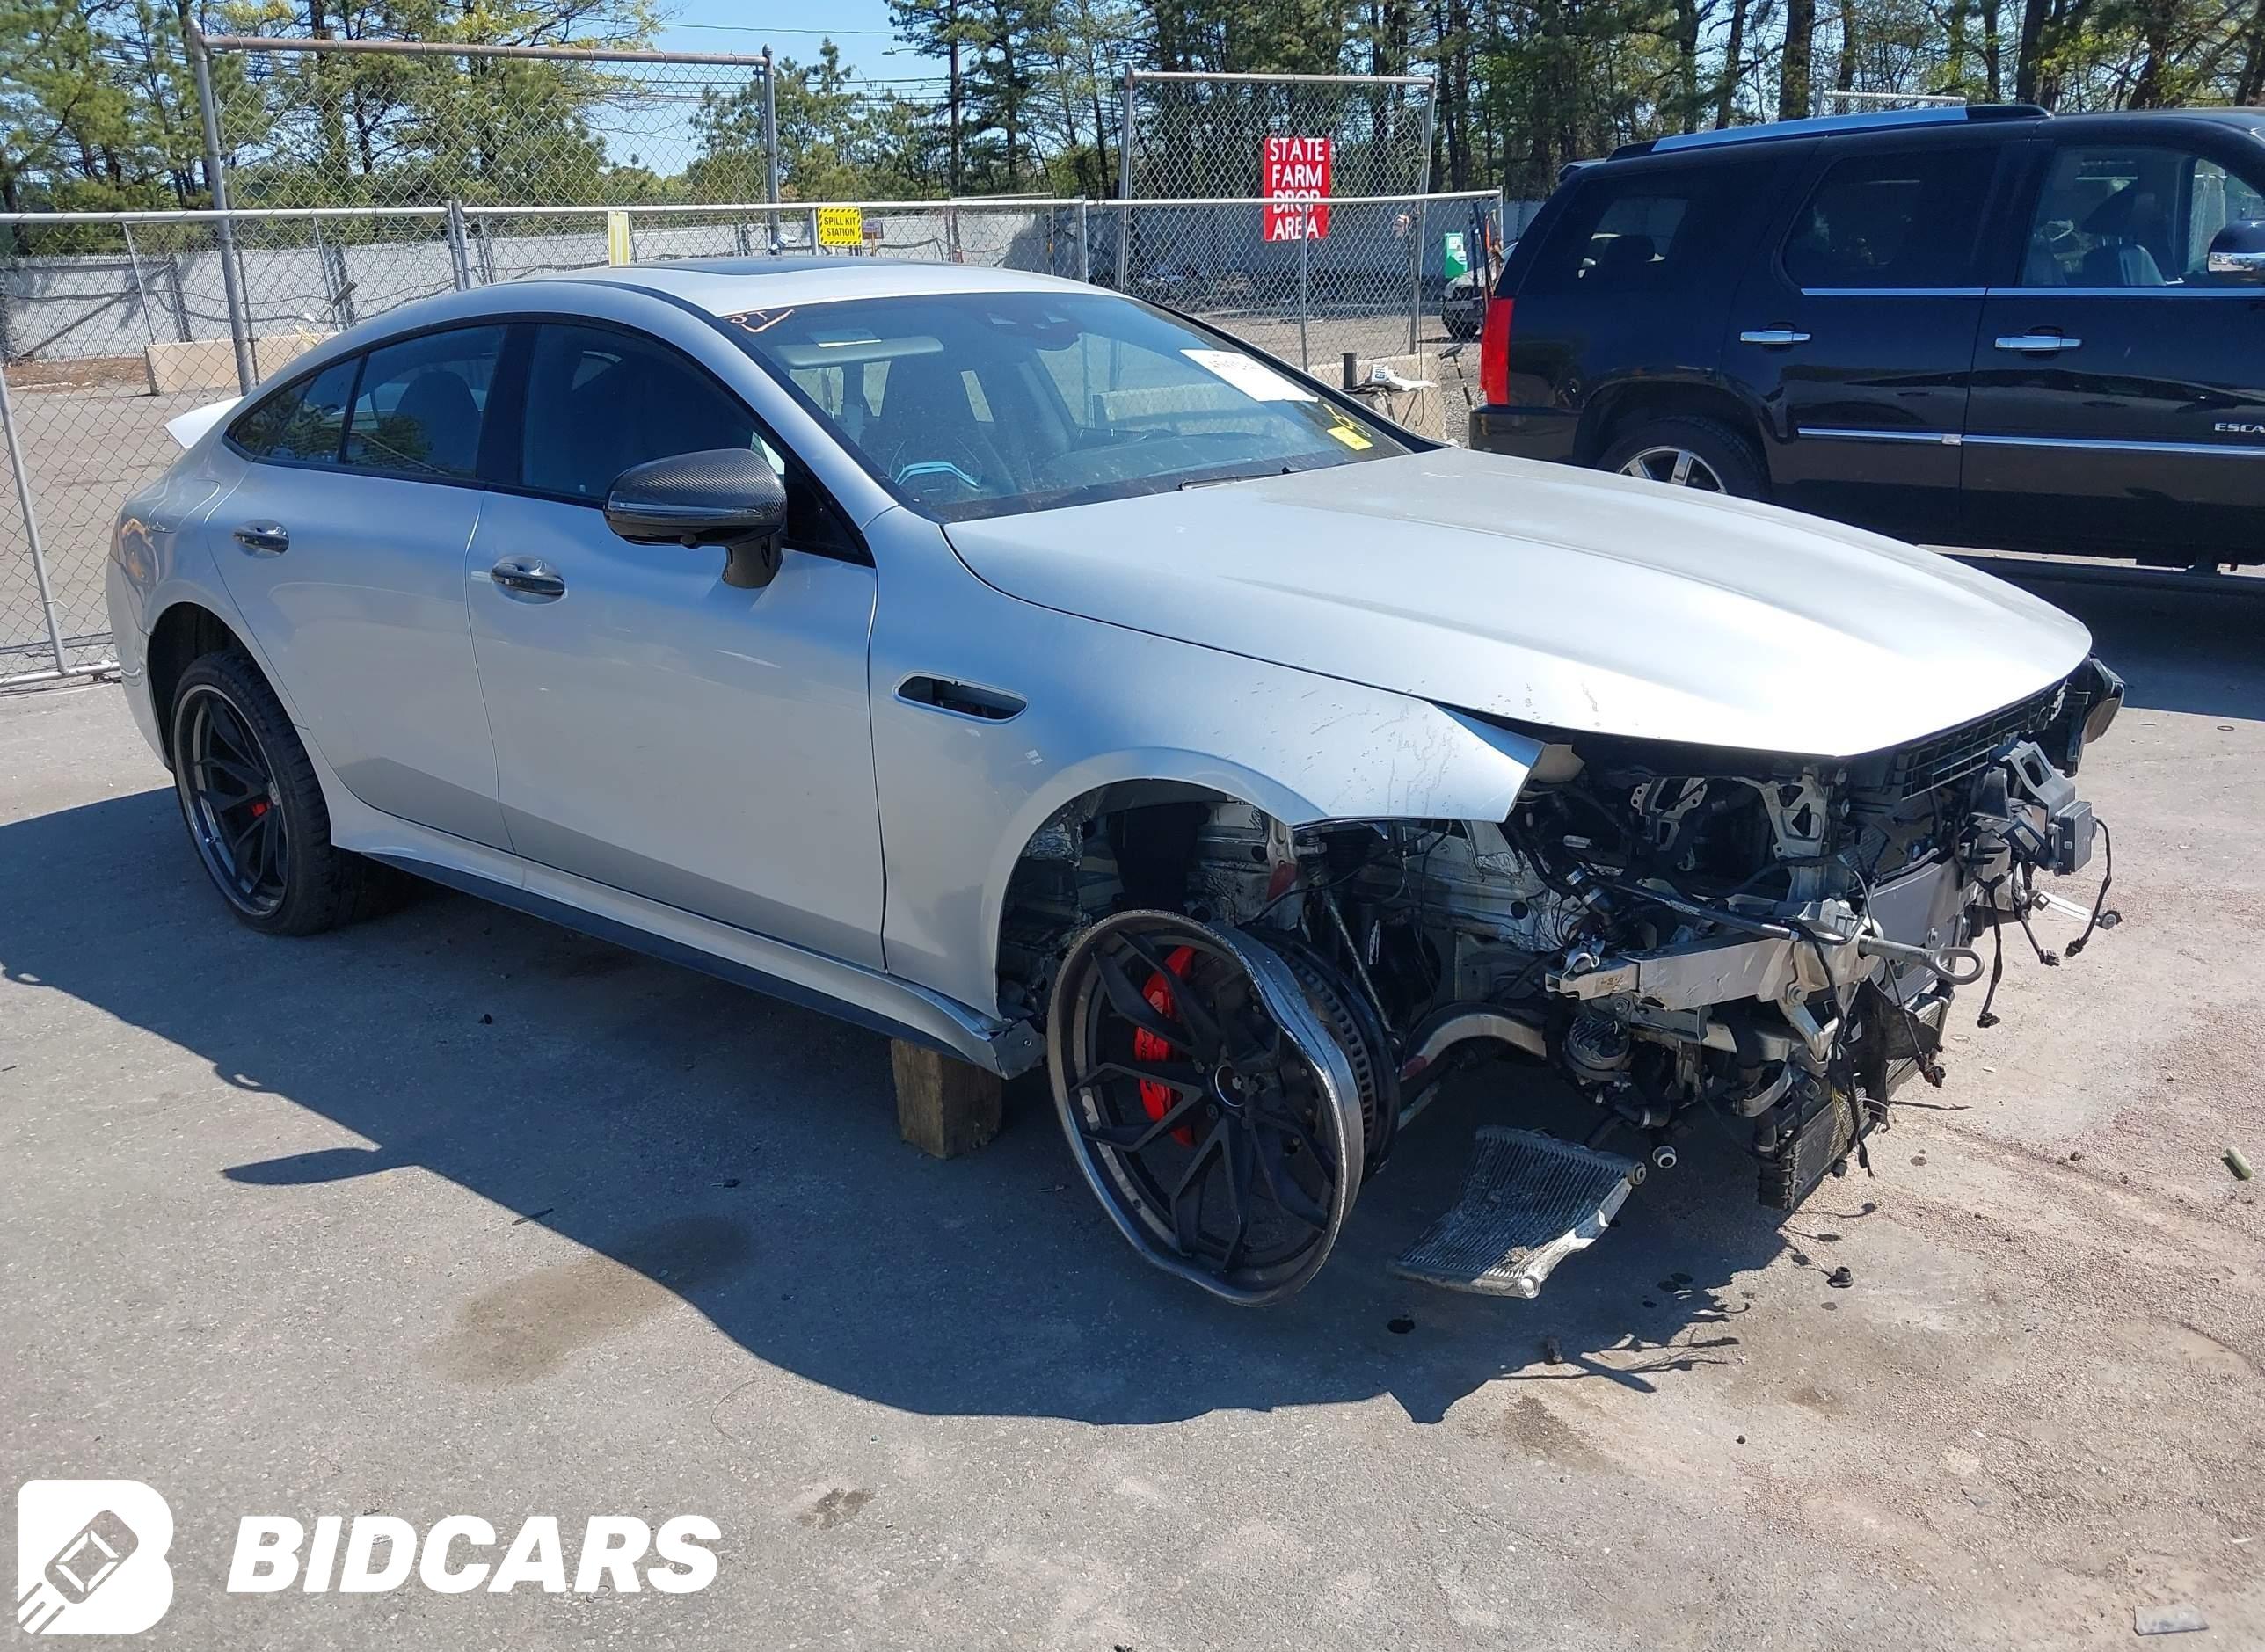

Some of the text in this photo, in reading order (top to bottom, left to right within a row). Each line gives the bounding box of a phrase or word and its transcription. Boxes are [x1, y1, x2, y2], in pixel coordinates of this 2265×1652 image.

[1269, 138, 1325, 162] STATE
[1271, 164, 1322, 188] FARM
[827, 228, 855, 237] STATION
[1272, 216, 1320, 241] AREA
